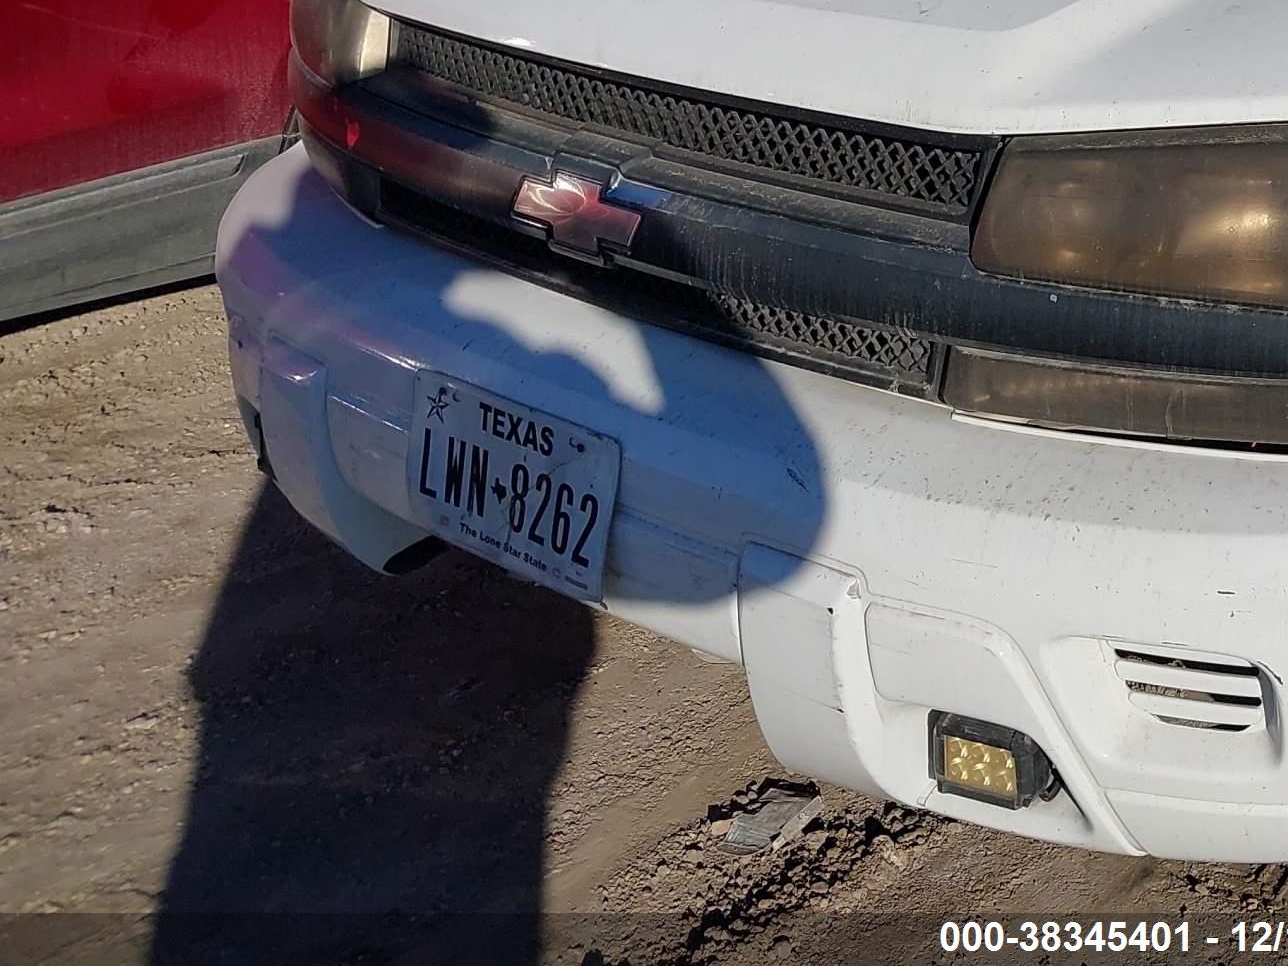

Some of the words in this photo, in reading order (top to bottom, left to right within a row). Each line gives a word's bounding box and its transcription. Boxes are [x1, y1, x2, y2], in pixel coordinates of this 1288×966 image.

[479, 401, 554, 457] TEXAS
[459, 521, 478, 537] The
[479, 530, 501, 549] Lone
[503, 540, 522, 559] Star
[523, 551, 548, 572] State
